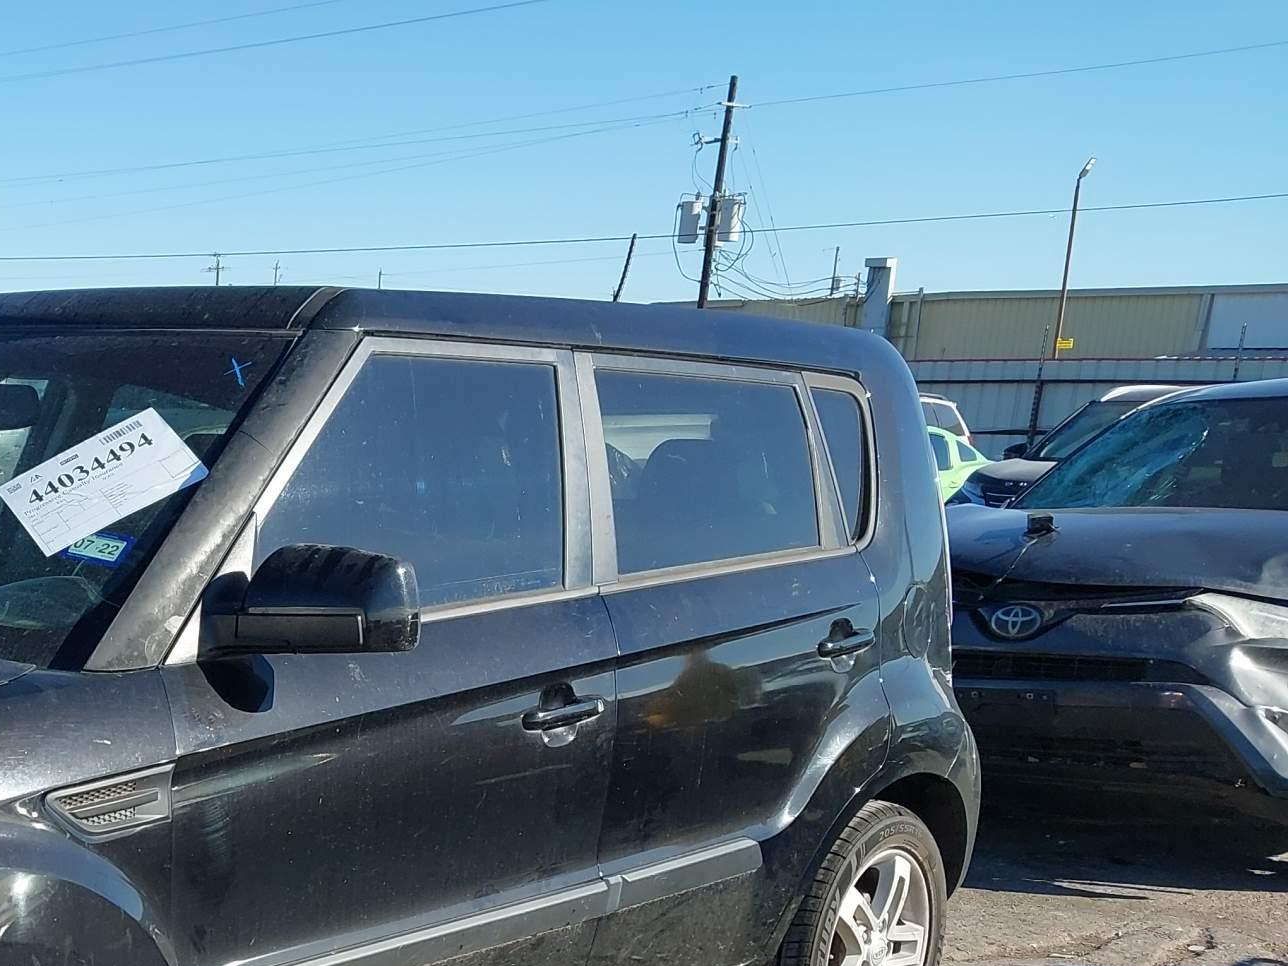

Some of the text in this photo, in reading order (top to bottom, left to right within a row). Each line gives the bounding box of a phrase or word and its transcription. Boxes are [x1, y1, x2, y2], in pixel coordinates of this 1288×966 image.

[28, 432, 154, 505] 44034494
[73, 539, 95, 550] 07
[98, 543, 120, 556] 22
